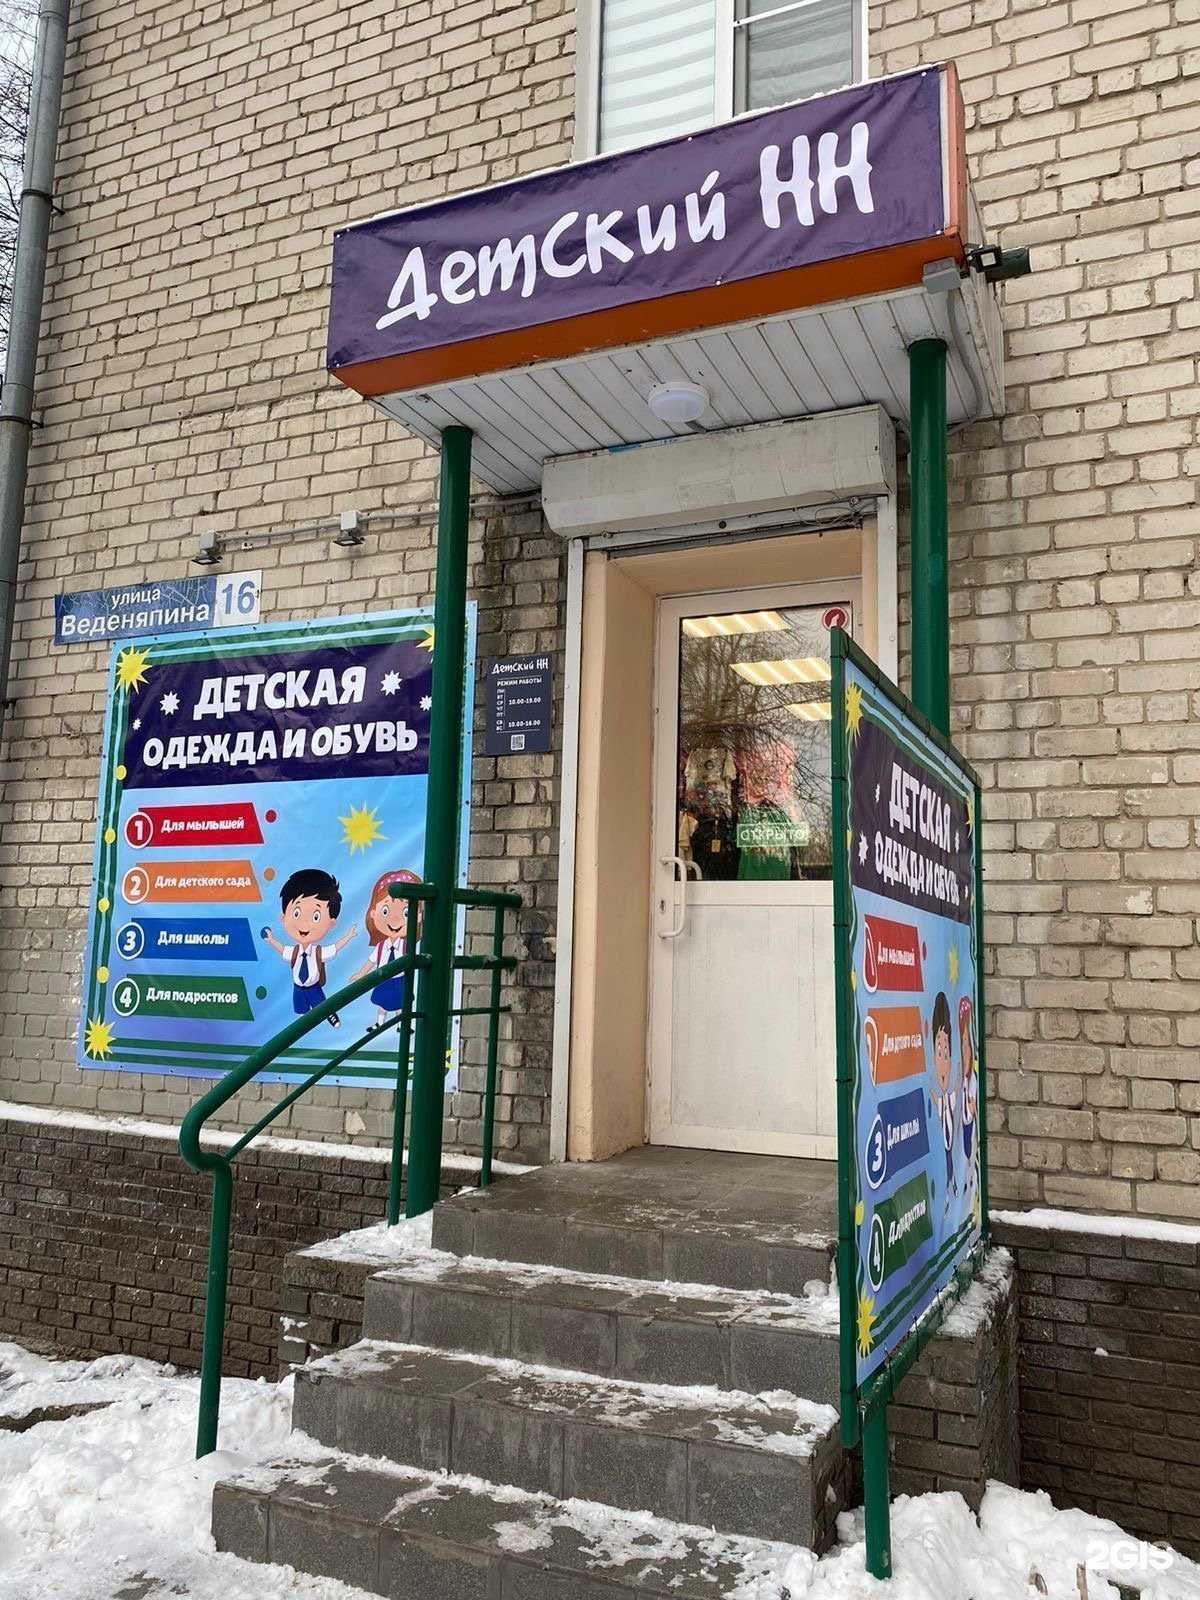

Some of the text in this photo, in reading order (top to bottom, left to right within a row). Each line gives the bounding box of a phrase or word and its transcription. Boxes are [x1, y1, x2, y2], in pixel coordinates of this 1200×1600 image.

[376, 121, 874, 330] Детский НН
[111, 588, 161, 610] улица
[222, 579, 256, 615] 16
[61, 603, 210, 636] Веденяпина
[491, 658, 548, 674] Детский НН
[192, 666, 367, 720] ДЕТСКАЯ
[142, 720, 418, 770] ОДЕЖДА И ОБУВЬ
[888, 761, 952, 854] ДЕТСКАЯ
[134, 816, 245, 840] 1 Для мылышей
[129, 875, 252, 896] 2 Для детского сада
[874, 831, 960, 906] ОДЕЖДА И ОБУВЬ
[123, 930, 230, 951] 3 Для школы
[119, 986, 239, 1008] 4 Для подростков
[872, 1131, 883, 1173] 3
[887, 1123, 900, 1151] Для
[873, 1231, 881, 1272] 4
